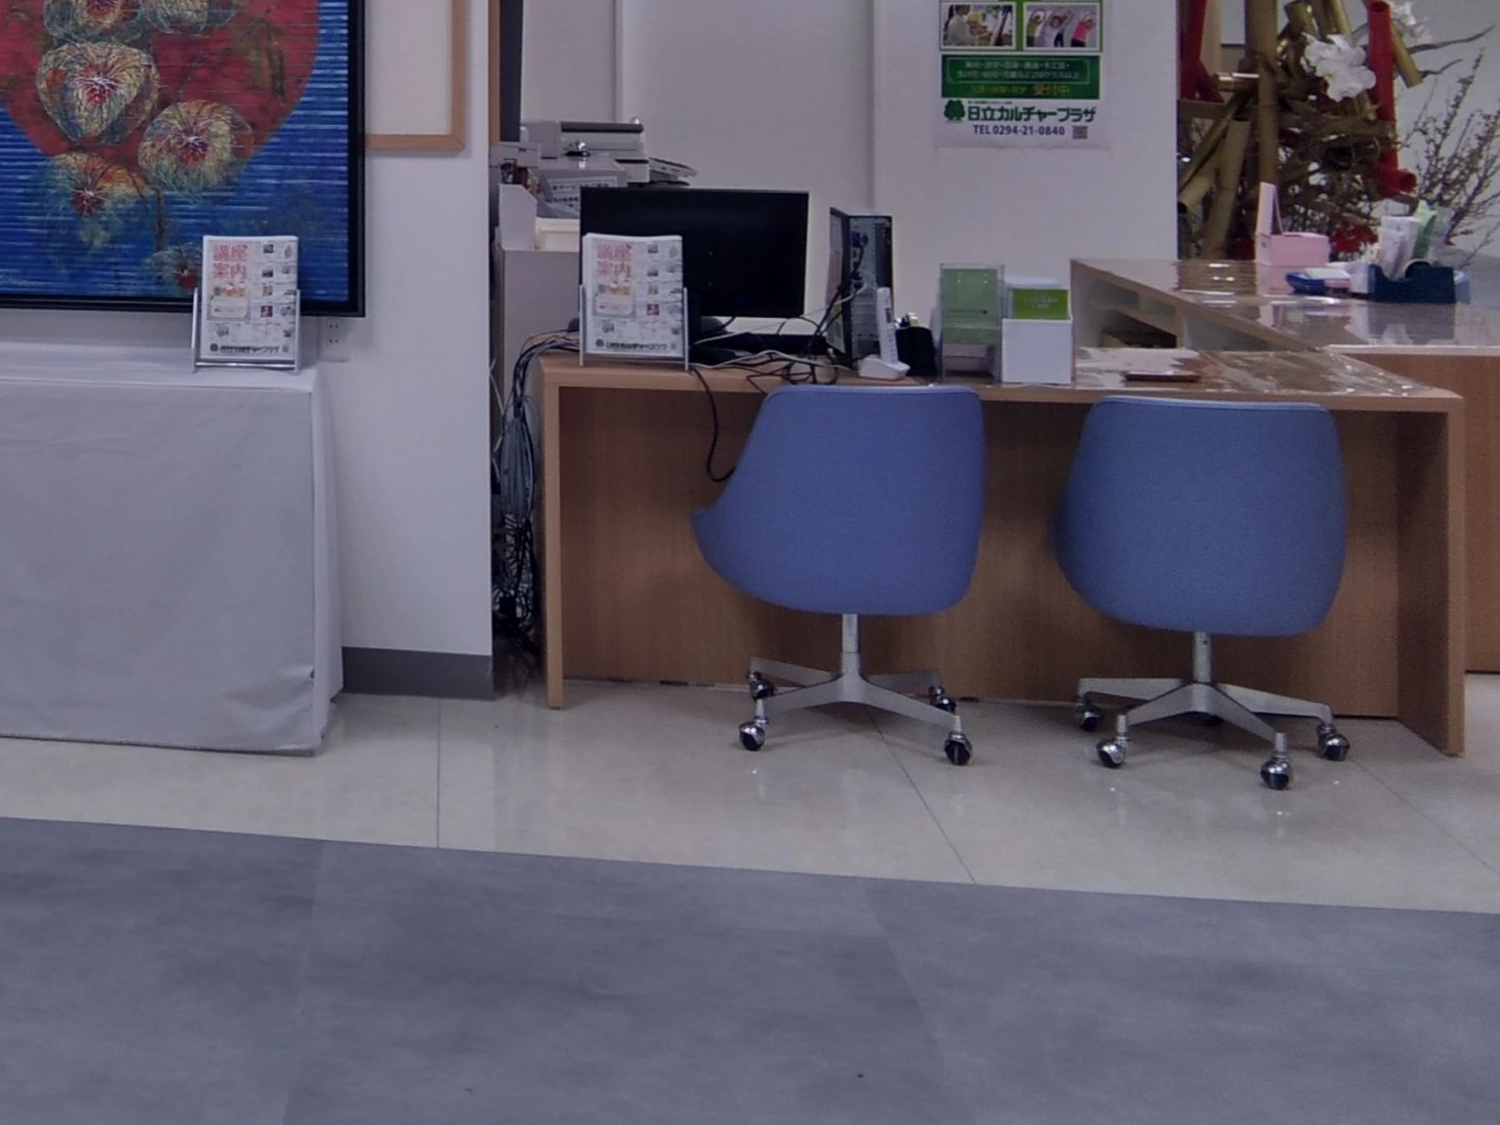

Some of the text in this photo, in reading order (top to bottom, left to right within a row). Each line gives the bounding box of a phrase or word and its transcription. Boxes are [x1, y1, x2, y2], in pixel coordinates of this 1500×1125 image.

[967, 106, 1097, 123] 日立カルチャープラザ
[973, 125, 991, 135] TEL
